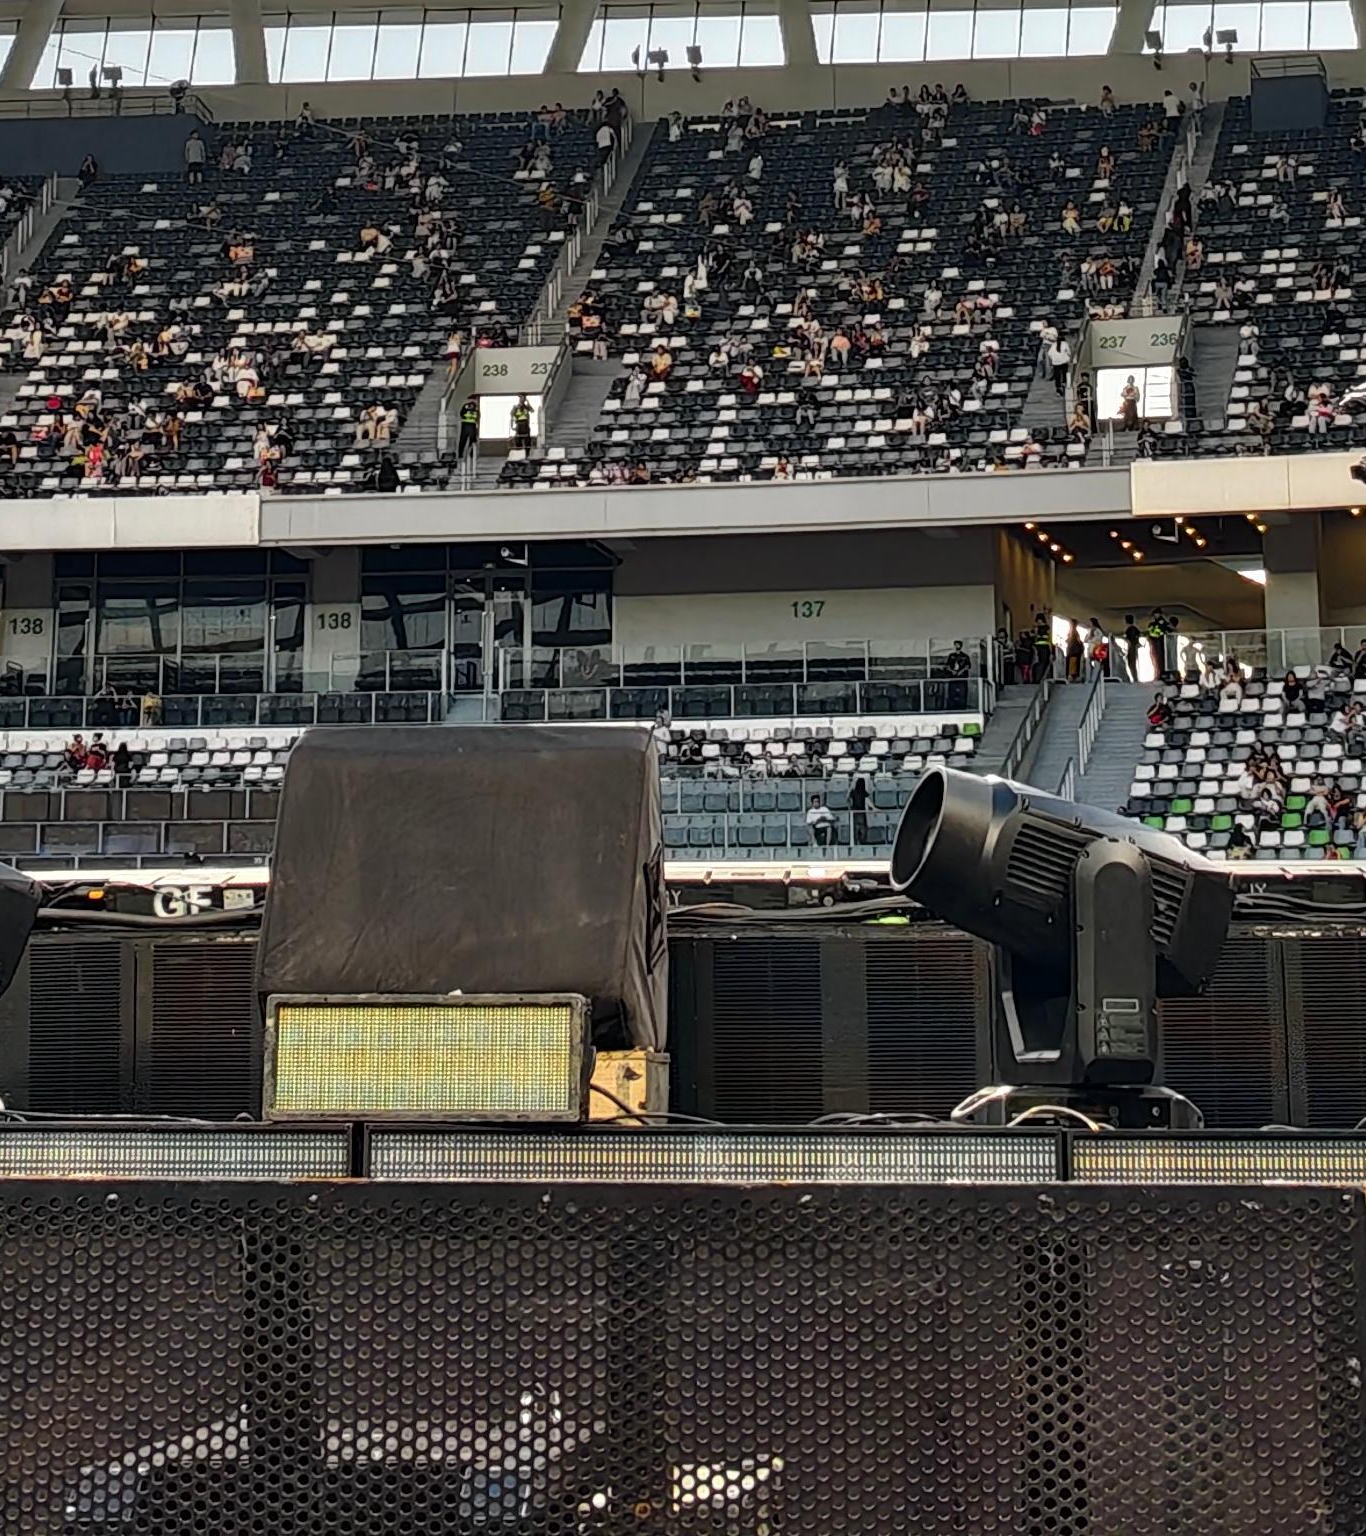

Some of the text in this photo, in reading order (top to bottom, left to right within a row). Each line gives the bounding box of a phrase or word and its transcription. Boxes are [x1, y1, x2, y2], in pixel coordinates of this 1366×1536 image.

[1099, 332, 1177, 349] 237 236
[482, 364, 509, 377] 238
[792, 600, 826, 618] 137
[9, 618, 43, 635] 138
[317, 612, 352, 630] 138
